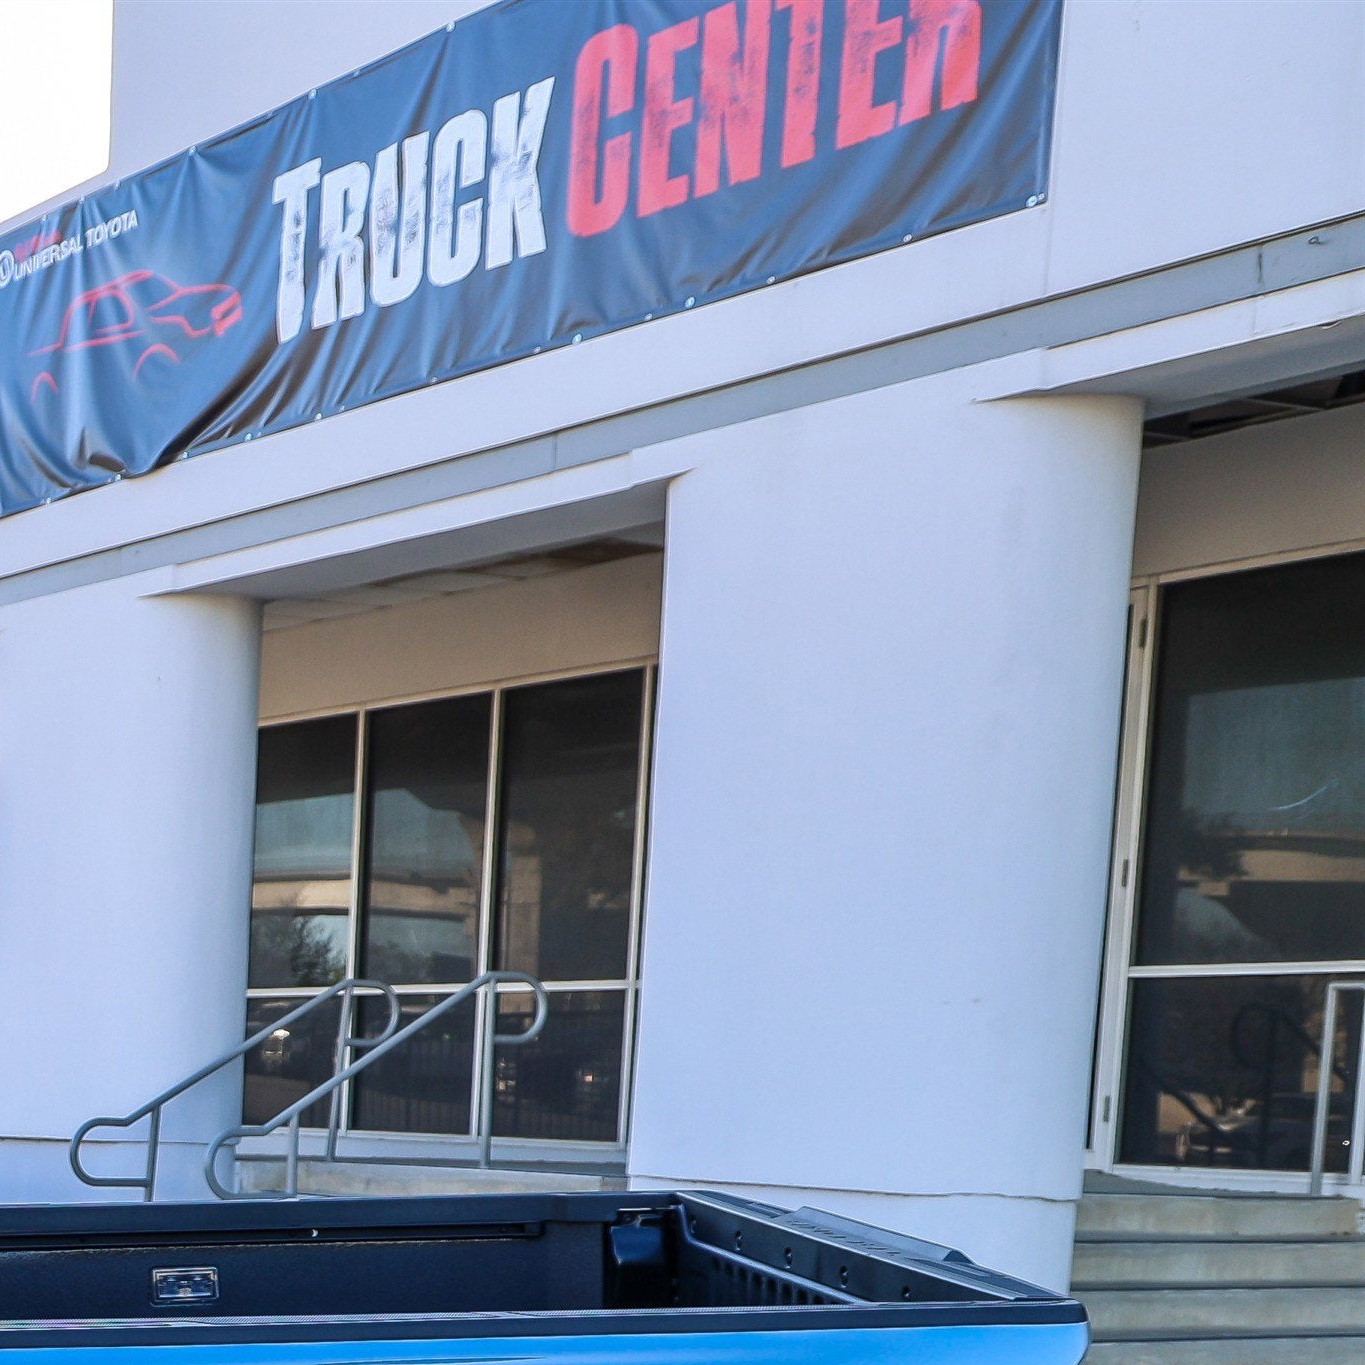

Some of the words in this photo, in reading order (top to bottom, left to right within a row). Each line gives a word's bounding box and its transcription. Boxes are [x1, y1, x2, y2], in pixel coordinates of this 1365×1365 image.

[85, 208, 139, 248] TOYOTA
[271, 76, 556, 345] TRUCK
[569, 0, 982, 237] CENTER
